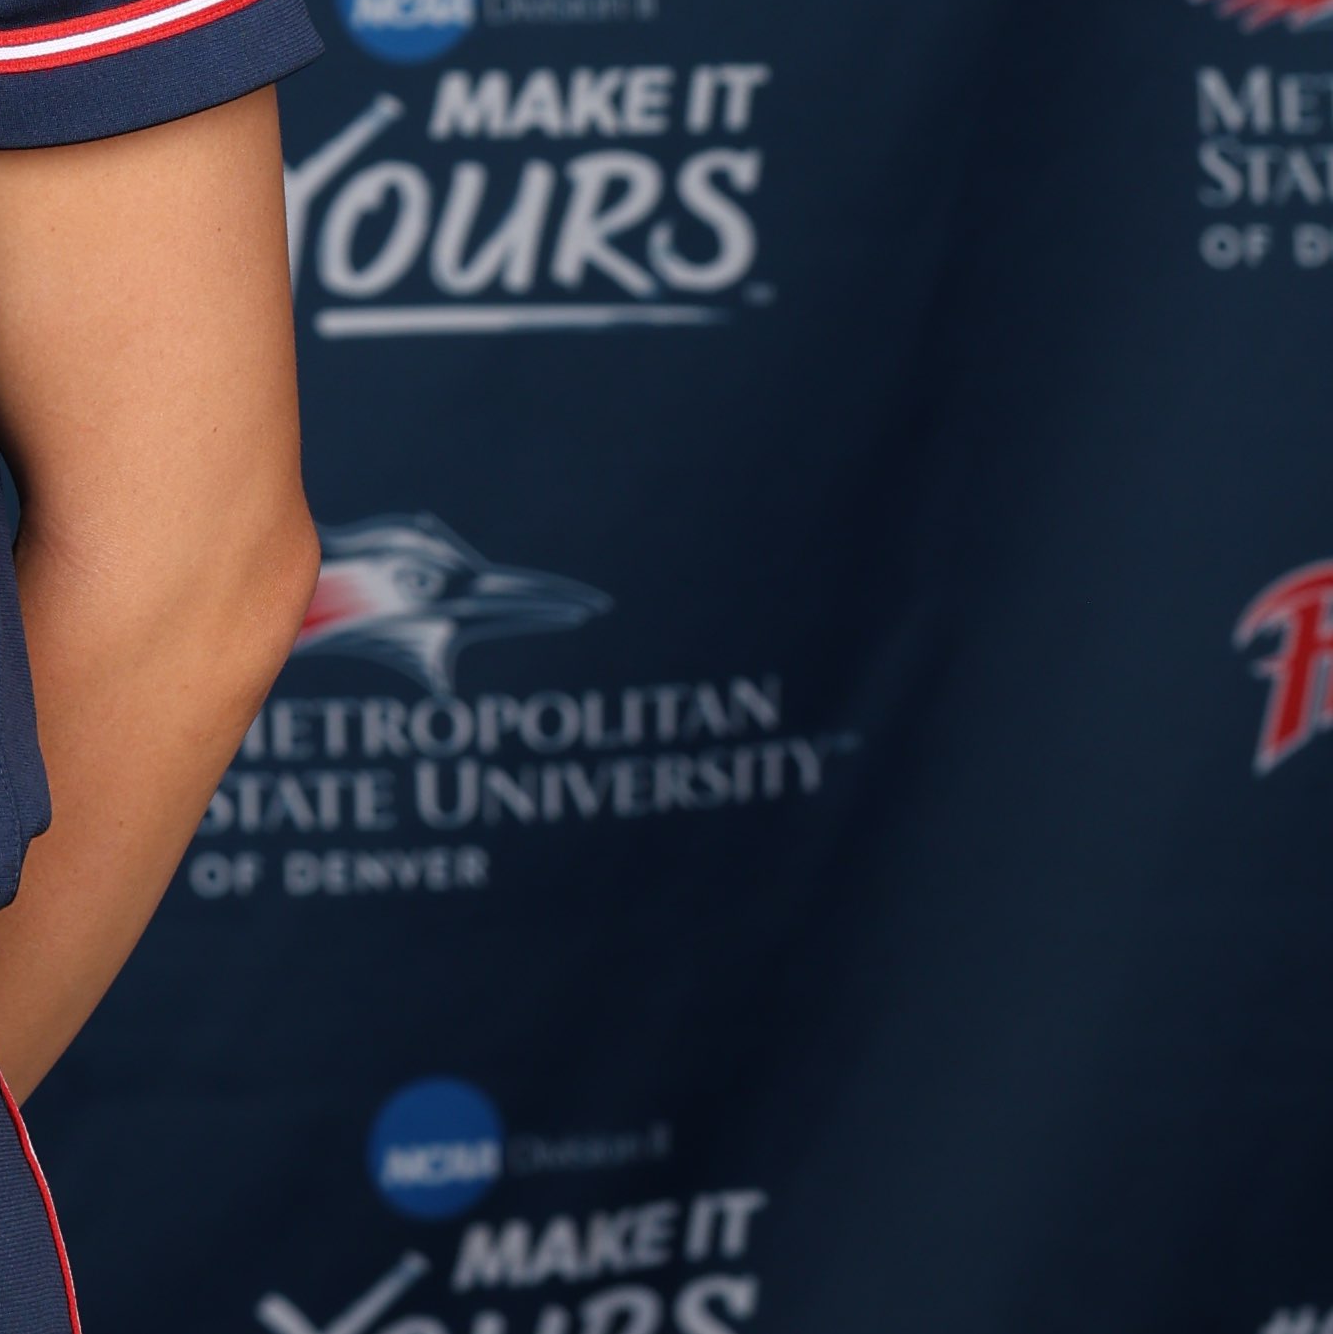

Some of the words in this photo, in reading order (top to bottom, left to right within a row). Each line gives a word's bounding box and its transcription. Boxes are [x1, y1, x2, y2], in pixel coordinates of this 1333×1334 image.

[427, 64, 677, 141] MAKE
[684, 62, 773, 136] IT
[1195, 66, 1333, 132] ME
[1199, 223, 1269, 270] OF
[241, 674, 780, 761] ETROPOLITAN
[414, 738, 823, 829] UNIVERSITY
[189, 851, 263, 898] OF
[283, 845, 490, 895] DENVER
[450, 1197, 682, 1295] MAKE
[682, 1186, 771, 1263] IT
